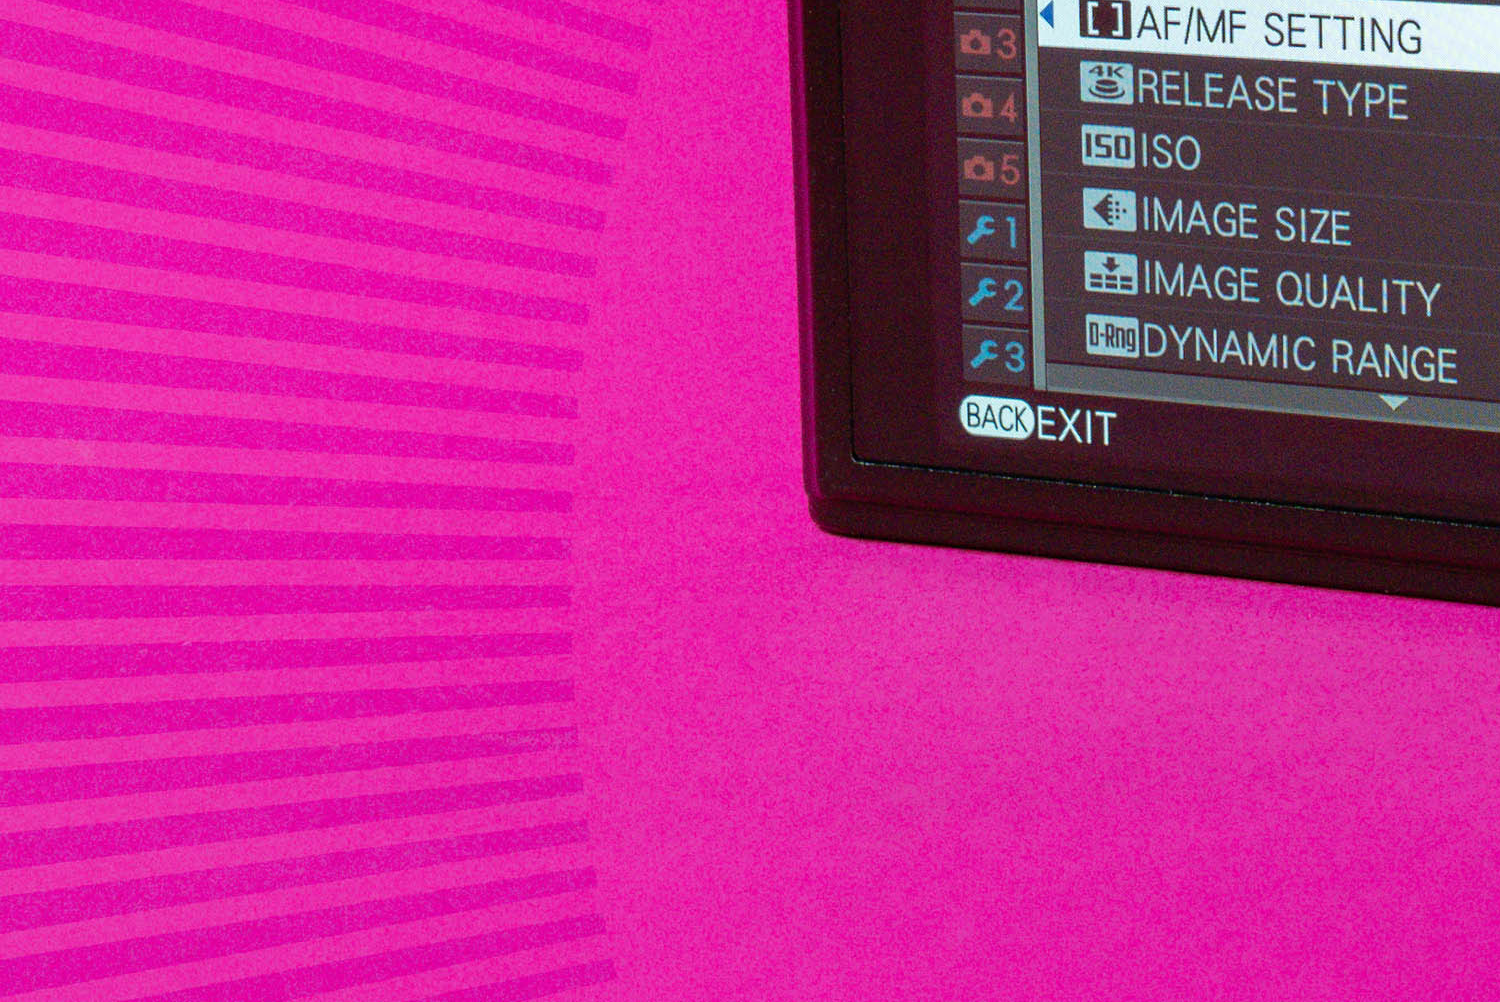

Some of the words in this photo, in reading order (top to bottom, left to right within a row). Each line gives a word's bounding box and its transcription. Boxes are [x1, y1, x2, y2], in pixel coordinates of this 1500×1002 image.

[997, 27, 1018, 59] 3
[1137, 5, 1248, 46] AF/MF
[1264, 12, 1423, 55] SETTING
[1087, 63, 1126, 80] 4K
[999, 91, 1018, 123] 4
[1139, 69, 1298, 113] RELEASE
[1313, 79, 1409, 120] TYPE
[1085, 132, 1132, 161] ISO
[1141, 133, 1201, 172] ISO
[1000, 154, 1021, 186] 5
[1005, 215, 1018, 249] 1
[1143, 196, 1259, 240] IMAGE
[1275, 206, 1352, 246] SIZE
[1004, 279, 1025, 312] 2
[1144, 260, 1260, 303] IMAGE
[1276, 270, 1442, 318] QUALITY
[1089, 321, 1137, 353] D-Rng
[1144, 323, 1316, 371] DYNAMIC
[1331, 340, 1458, 384] RANGE
[1005, 341, 1026, 373] 3
[966, 401, 1029, 434] BACK
[1037, 405, 1117, 446] EXIT
